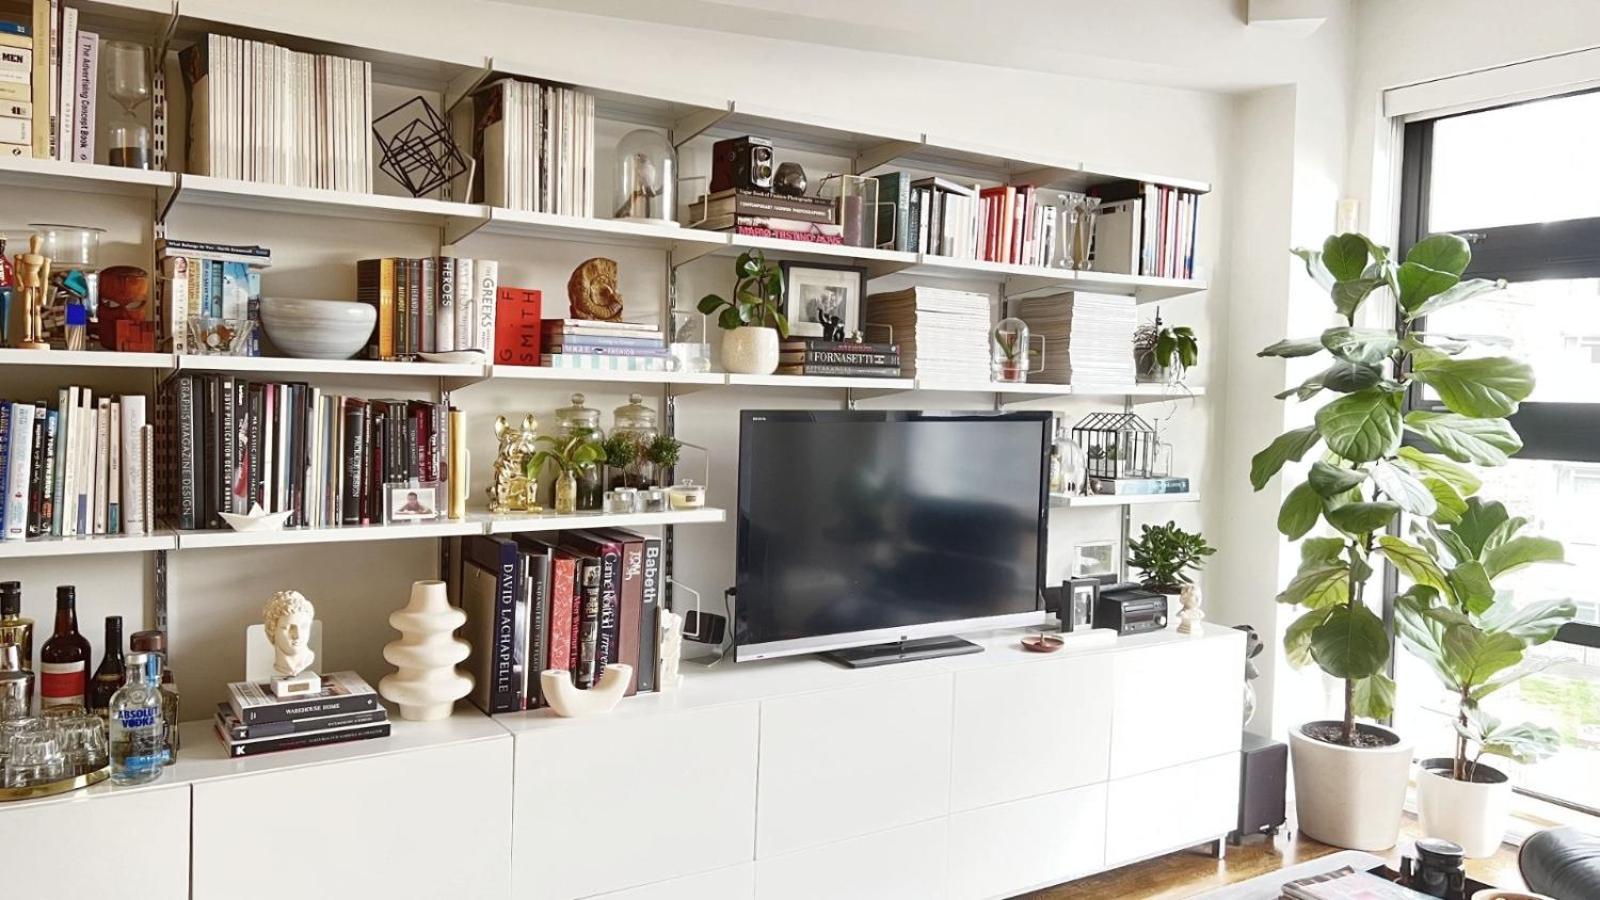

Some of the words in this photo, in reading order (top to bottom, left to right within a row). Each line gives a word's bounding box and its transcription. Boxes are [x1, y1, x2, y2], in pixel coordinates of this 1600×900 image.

[2, 52, 24, 64] MEN
[82, 44, 91, 57] The
[80, 57, 91, 98] Advertising
[79, 99, 90, 129] Concept
[79, 130, 89, 149] Book
[442, 260, 454, 307] HEROES
[481, 277, 494, 329] GREEKS
[519, 291, 534, 362] SMITH
[814, 351, 873, 364] FORNASETTI
[180, 378, 191, 420] GRAPHIS
[181, 420, 192, 477] MAGAZINE
[224, 413, 232, 457] PUBLICATION
[182, 478, 192, 516] DESIGN
[502, 563, 514, 605] DAVID
[603, 552, 617, 588] Carine
[643, 546, 659, 604] Babeth
[602, 591, 615, 629] Roitfeld
[498, 609, 512, 693] LACHAPELLE
[571, 615, 580, 650] Without
[118, 707, 157, 719] ABSOLUT
[121, 717, 155, 728] VODKA
[285, 705, 322, 715] WAREHOUSE
[322, 703, 341, 711] HOME
[236, 745, 246, 755] K
